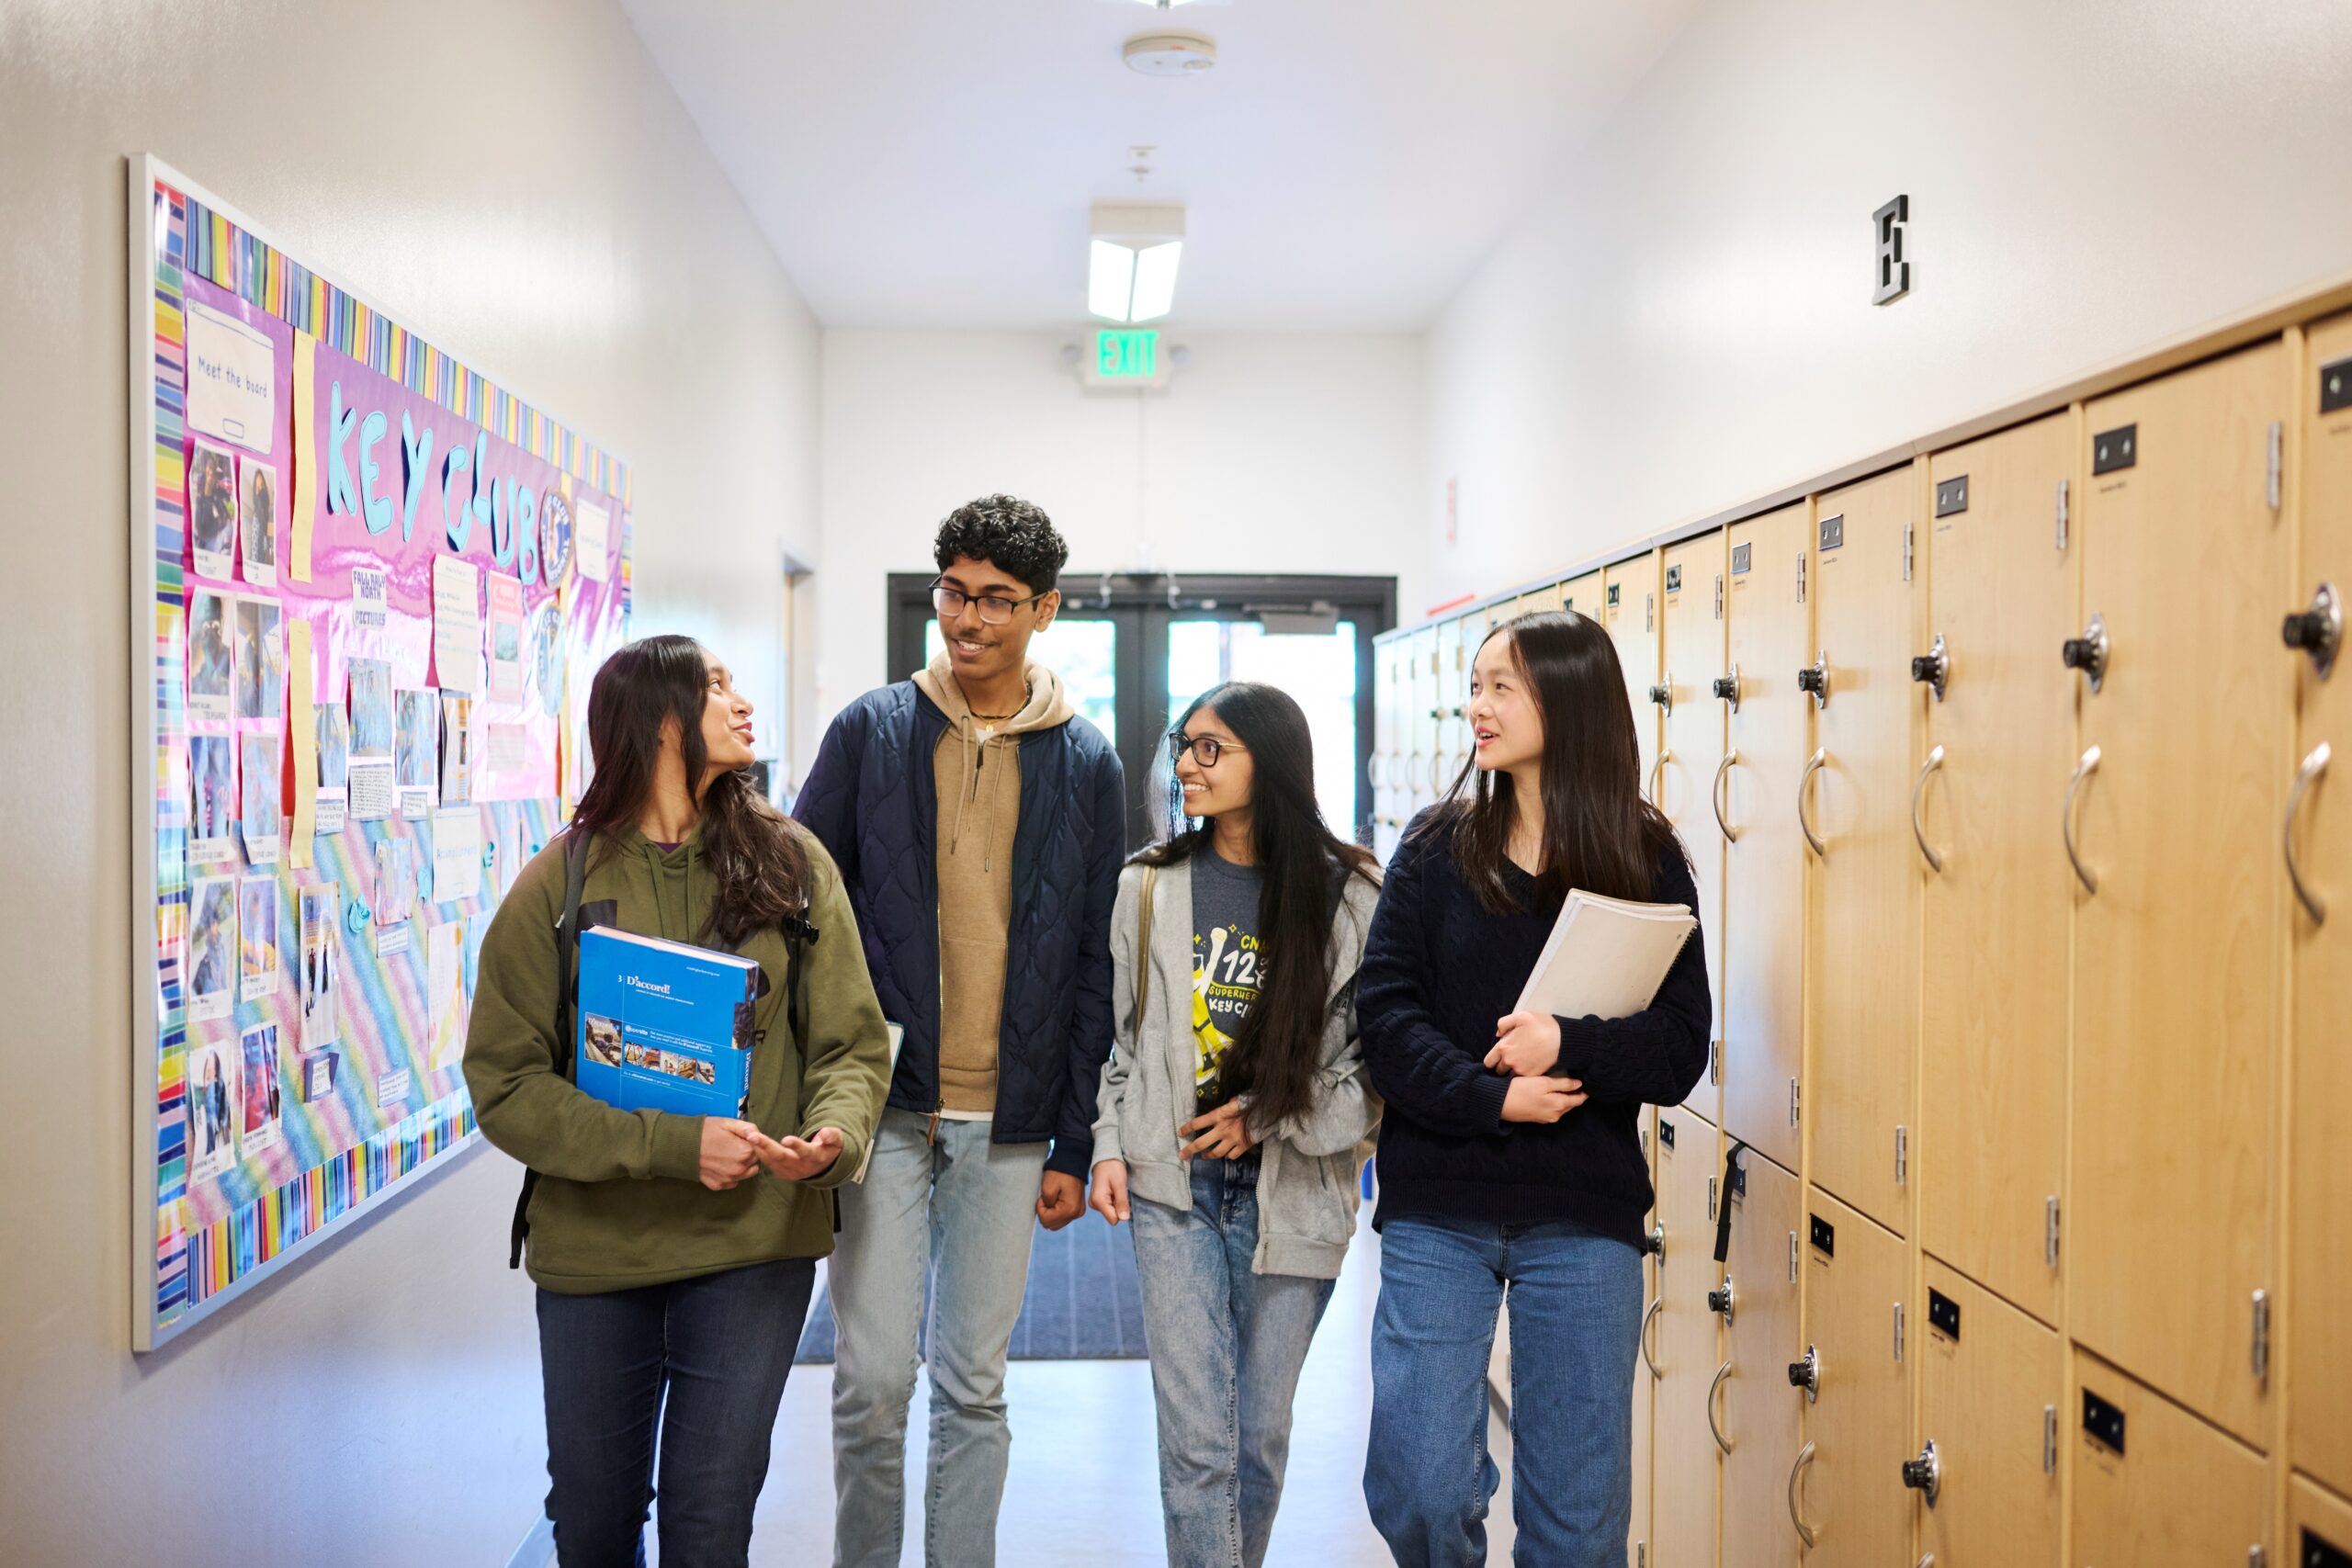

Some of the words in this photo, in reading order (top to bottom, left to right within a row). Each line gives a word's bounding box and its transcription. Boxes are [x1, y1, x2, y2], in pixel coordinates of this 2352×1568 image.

[1872, 195, 1909, 306] E
[1097, 329, 1159, 378] EXIT
[198, 355, 221, 379] Meet
[226, 367, 241, 389] the
[245, 374, 267, 398] board
[327, 380, 434, 542] KEY
[442, 428, 538, 586] CLUB
[353, 570, 369, 586] FALL
[361, 585, 381, 601] NORTH
[355, 610, 386, 626] PICTURES
[627, 976, 671, 994] D'accord!
[1208, 998, 1233, 1013] KEY
